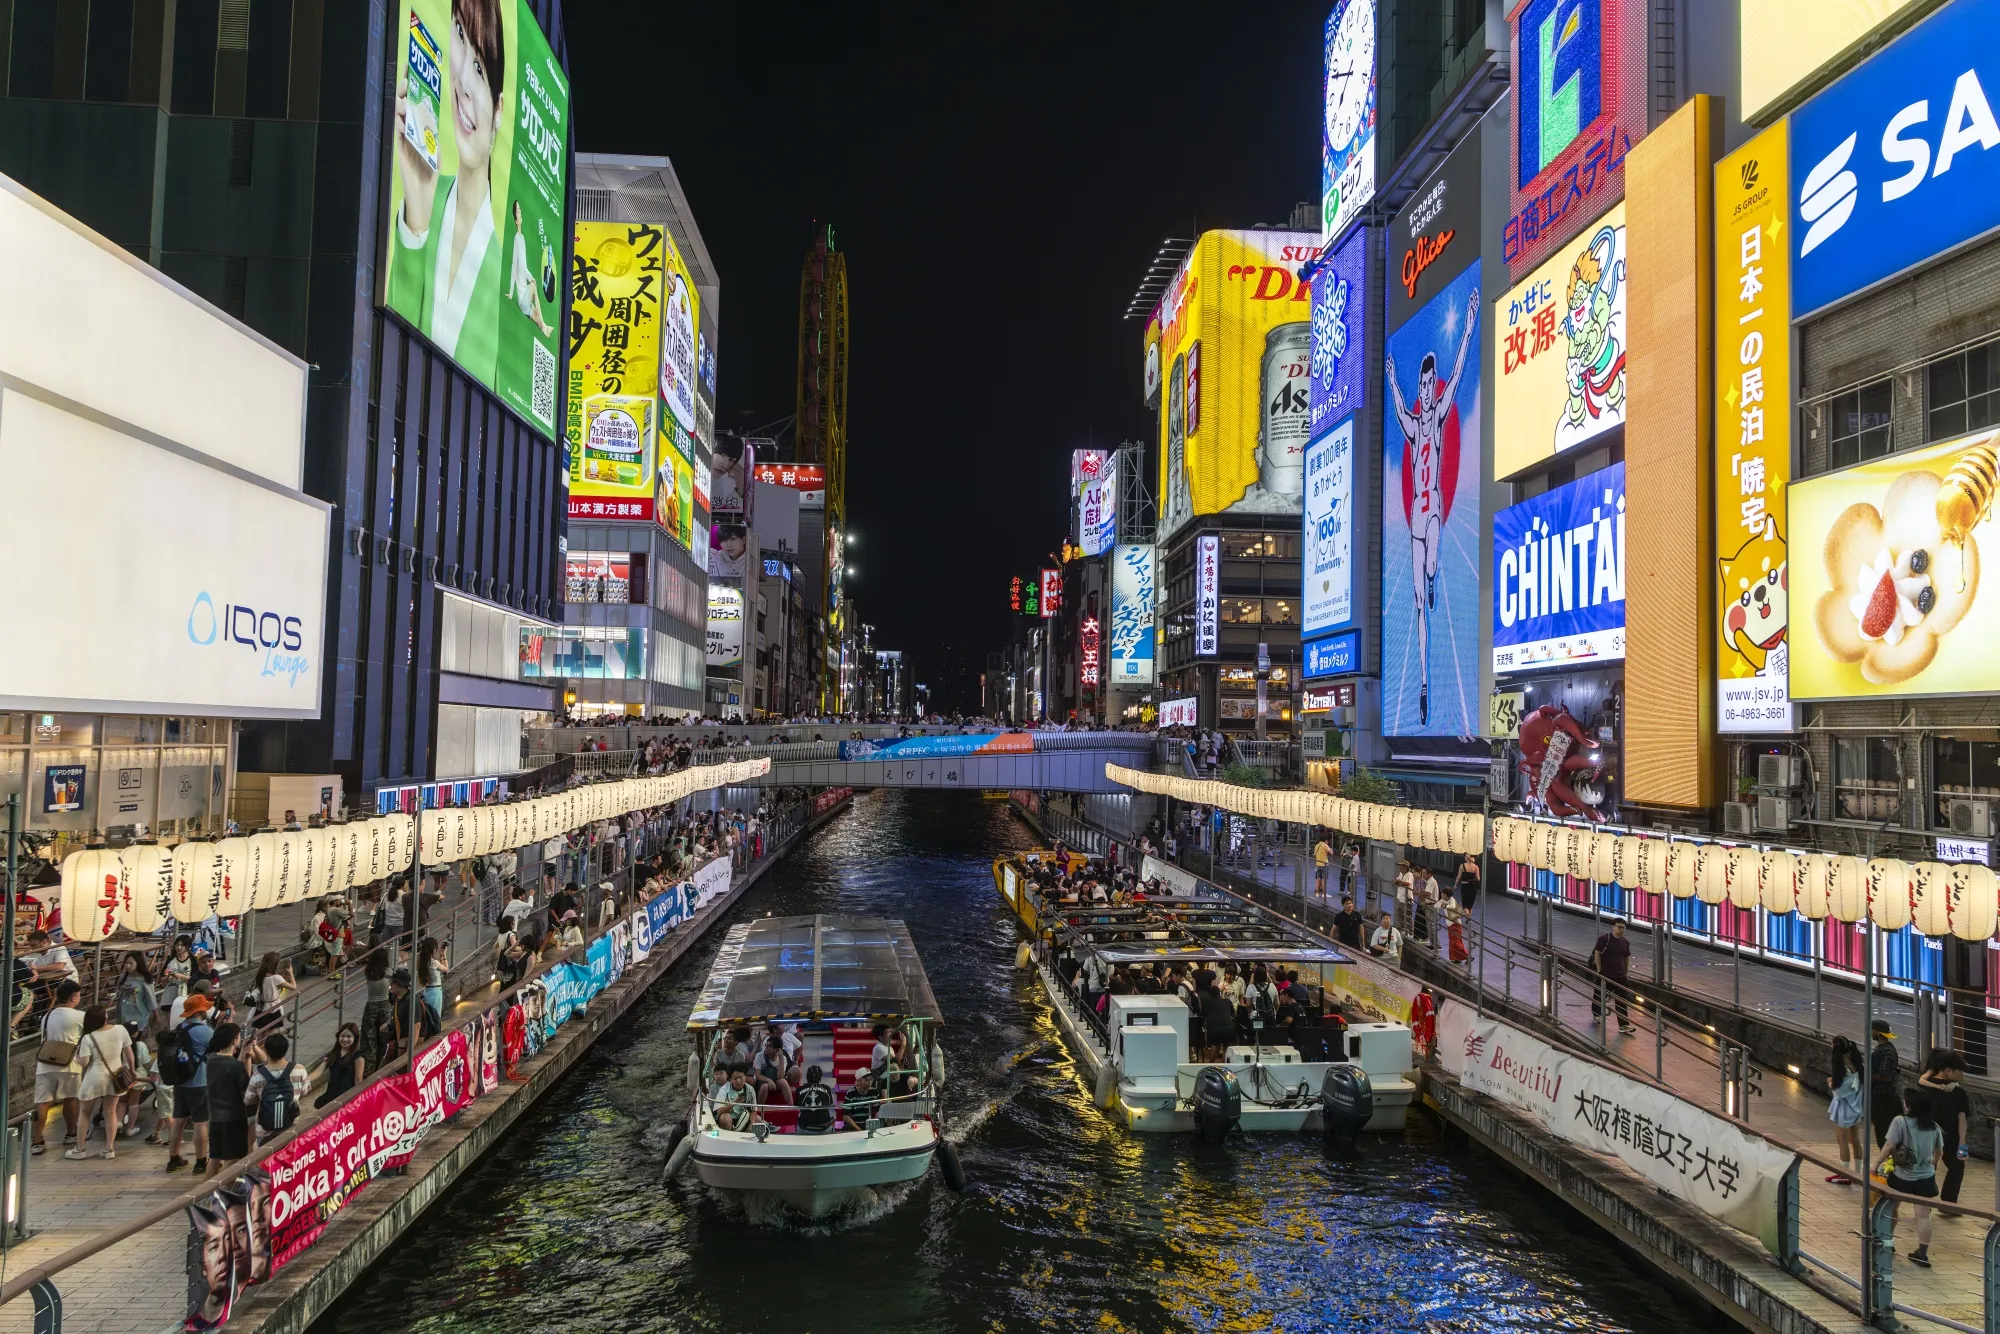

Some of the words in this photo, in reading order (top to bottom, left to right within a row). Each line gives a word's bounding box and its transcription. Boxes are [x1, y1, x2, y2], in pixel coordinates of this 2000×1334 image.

[411, 41, 441, 97] サロンパス
[521, 87, 562, 186] サロンパス
[1882, 68, 2000, 203] SA
[1341, 157, 1362, 204] ピップ
[1503, 126, 1631, 265] 日商エステム
[1733, 203, 1742, 216] JS
[1743, 187, 1768, 210] GROUP
[627, 223, 662, 327] ウェスト
[1402, 230, 1455, 299] Glico
[1509, 279, 1552, 327] かぜに
[597, 297, 633, 395] 周囲径の
[1504, 300, 1556, 376] 改源
[1312, 385, 1348, 426] 雪印メグミルク
[762, 470, 796, 485] 免税
[1310, 436, 1348, 477] 創業100周年
[1420, 437, 1431, 514] グリコ
[1314, 466, 1342, 498] ありがとう
[567, 502, 642, 516] 山本漢方製薬
[1124, 546, 1153, 627] シャッターは
[1204, 554, 1215, 593] 本場の味
[224, 603, 302, 652] IQOS
[1202, 597, 1216, 651] かに道楽
[261, 640, 309, 688] Lounge
[1081, 617, 1098, 684] 大王将
[1319, 652, 1349, 670] 雪印メグミルク
[1309, 694, 1336, 707] ZETTERIA
[1725, 707, 1785, 720] 06-4963-3661
[1726, 685, 1784, 704] www.jsv.jp
[885, 769, 958, 782] えびす橋
[387, 827, 396, 872] PABLO
[436, 818, 445, 857] PABLO
[1939, 842, 1964, 858] BAR
[18, 904, 38, 912] MENU
[156, 858, 173, 918] 三津寺
[1464, 1029, 1485, 1064] 美
[1490, 1045, 1563, 1103] Beautiful
[1573, 1089, 1740, 1200] 大阪樟蔭女子大学
